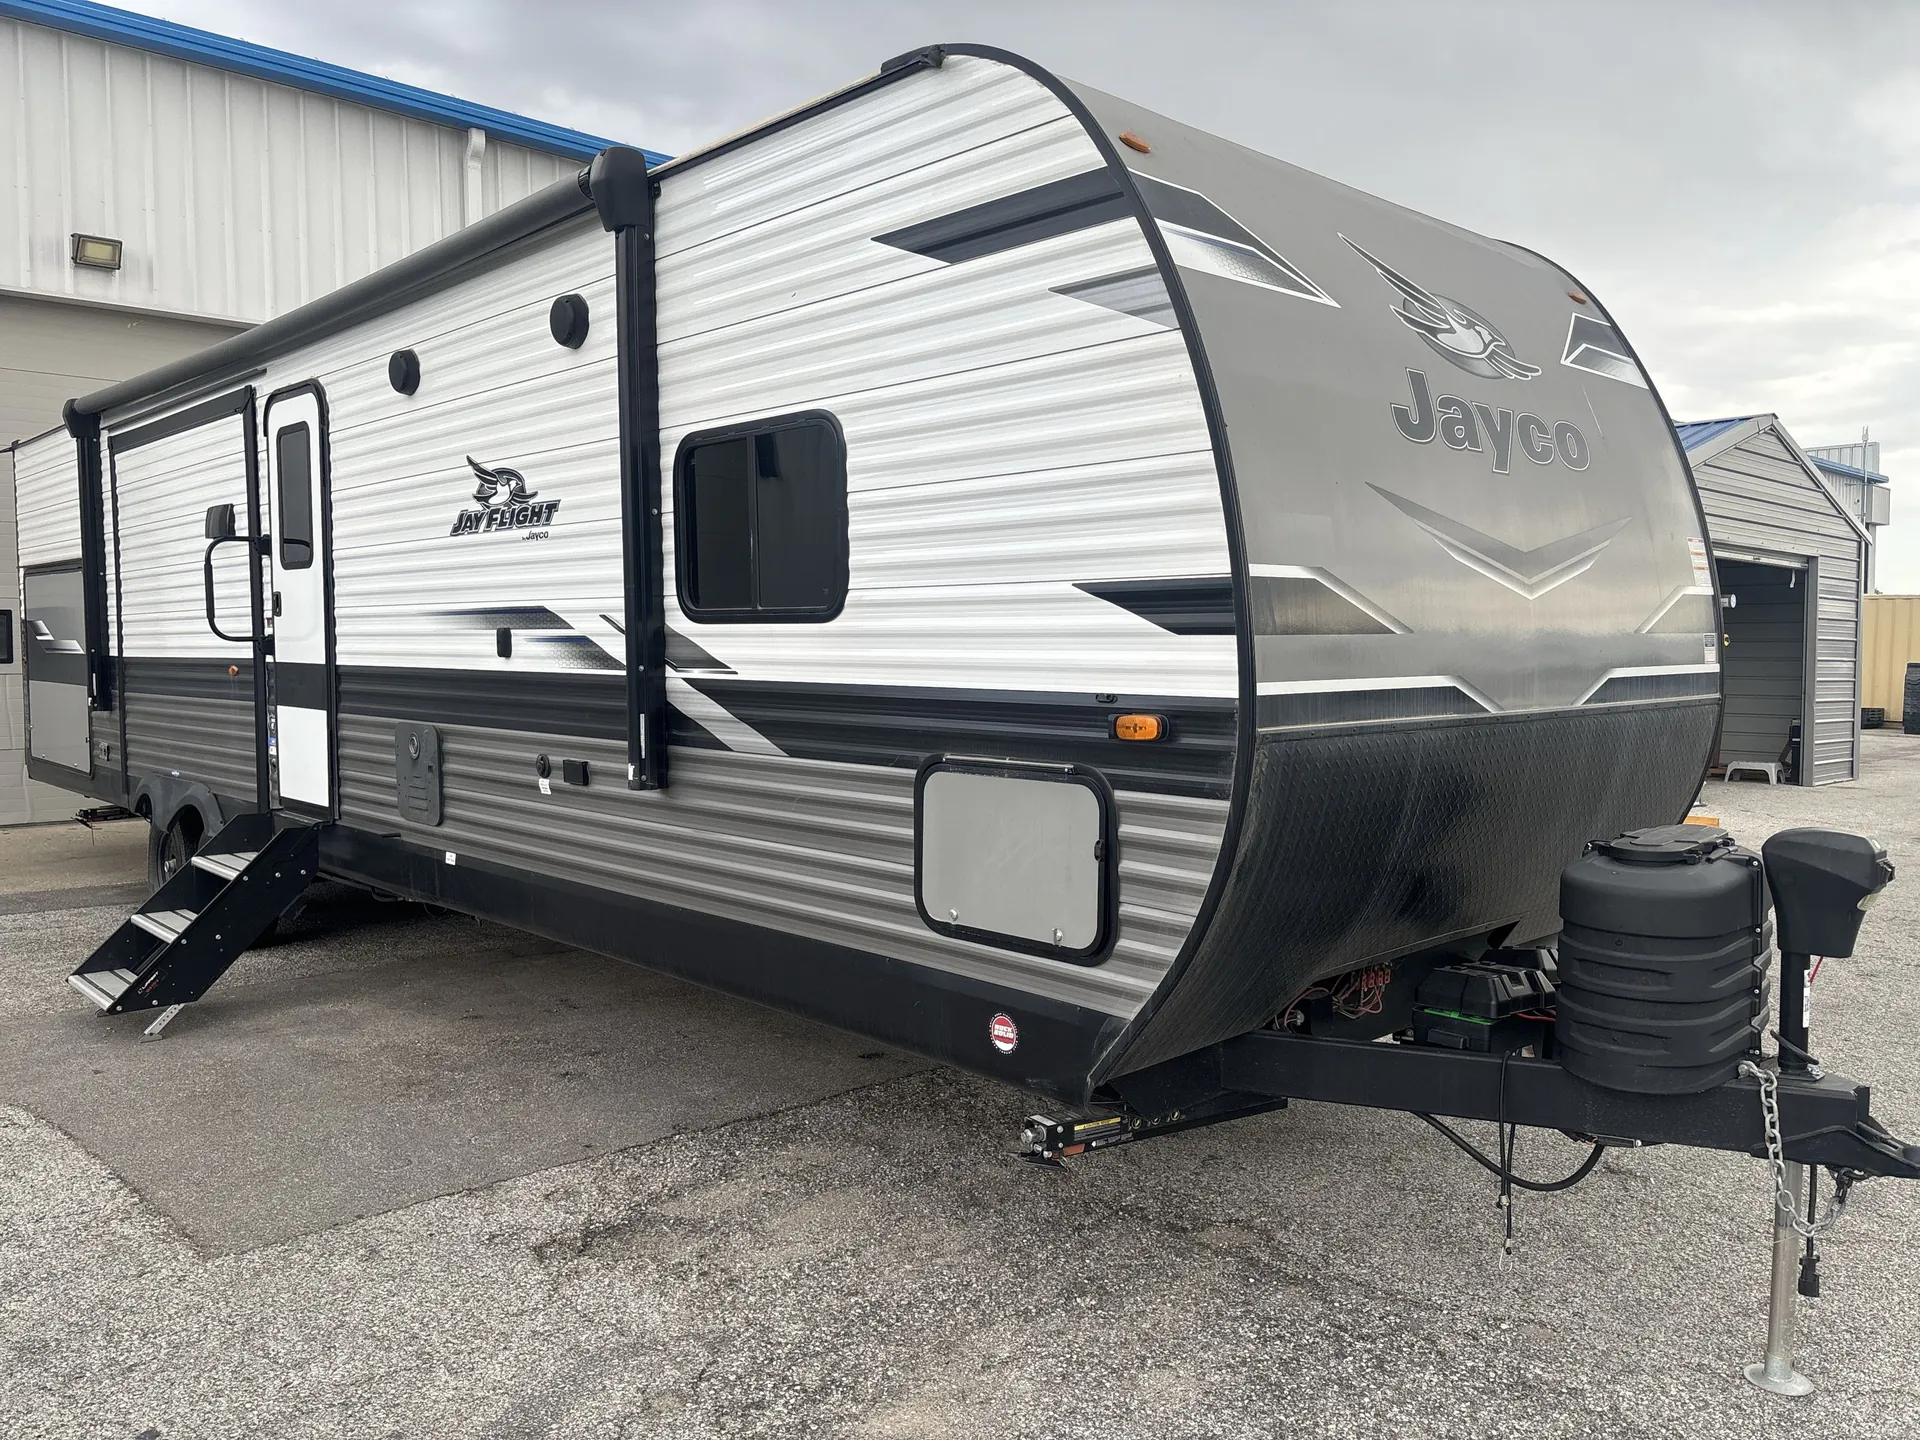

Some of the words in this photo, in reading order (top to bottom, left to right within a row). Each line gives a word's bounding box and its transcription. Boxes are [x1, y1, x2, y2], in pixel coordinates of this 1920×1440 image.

[1390, 367, 1591, 474] Jayco
[450, 509, 487, 536] JAY
[483, 499, 561, 532] FLIGHT
[526, 530, 549, 541] Jayco
